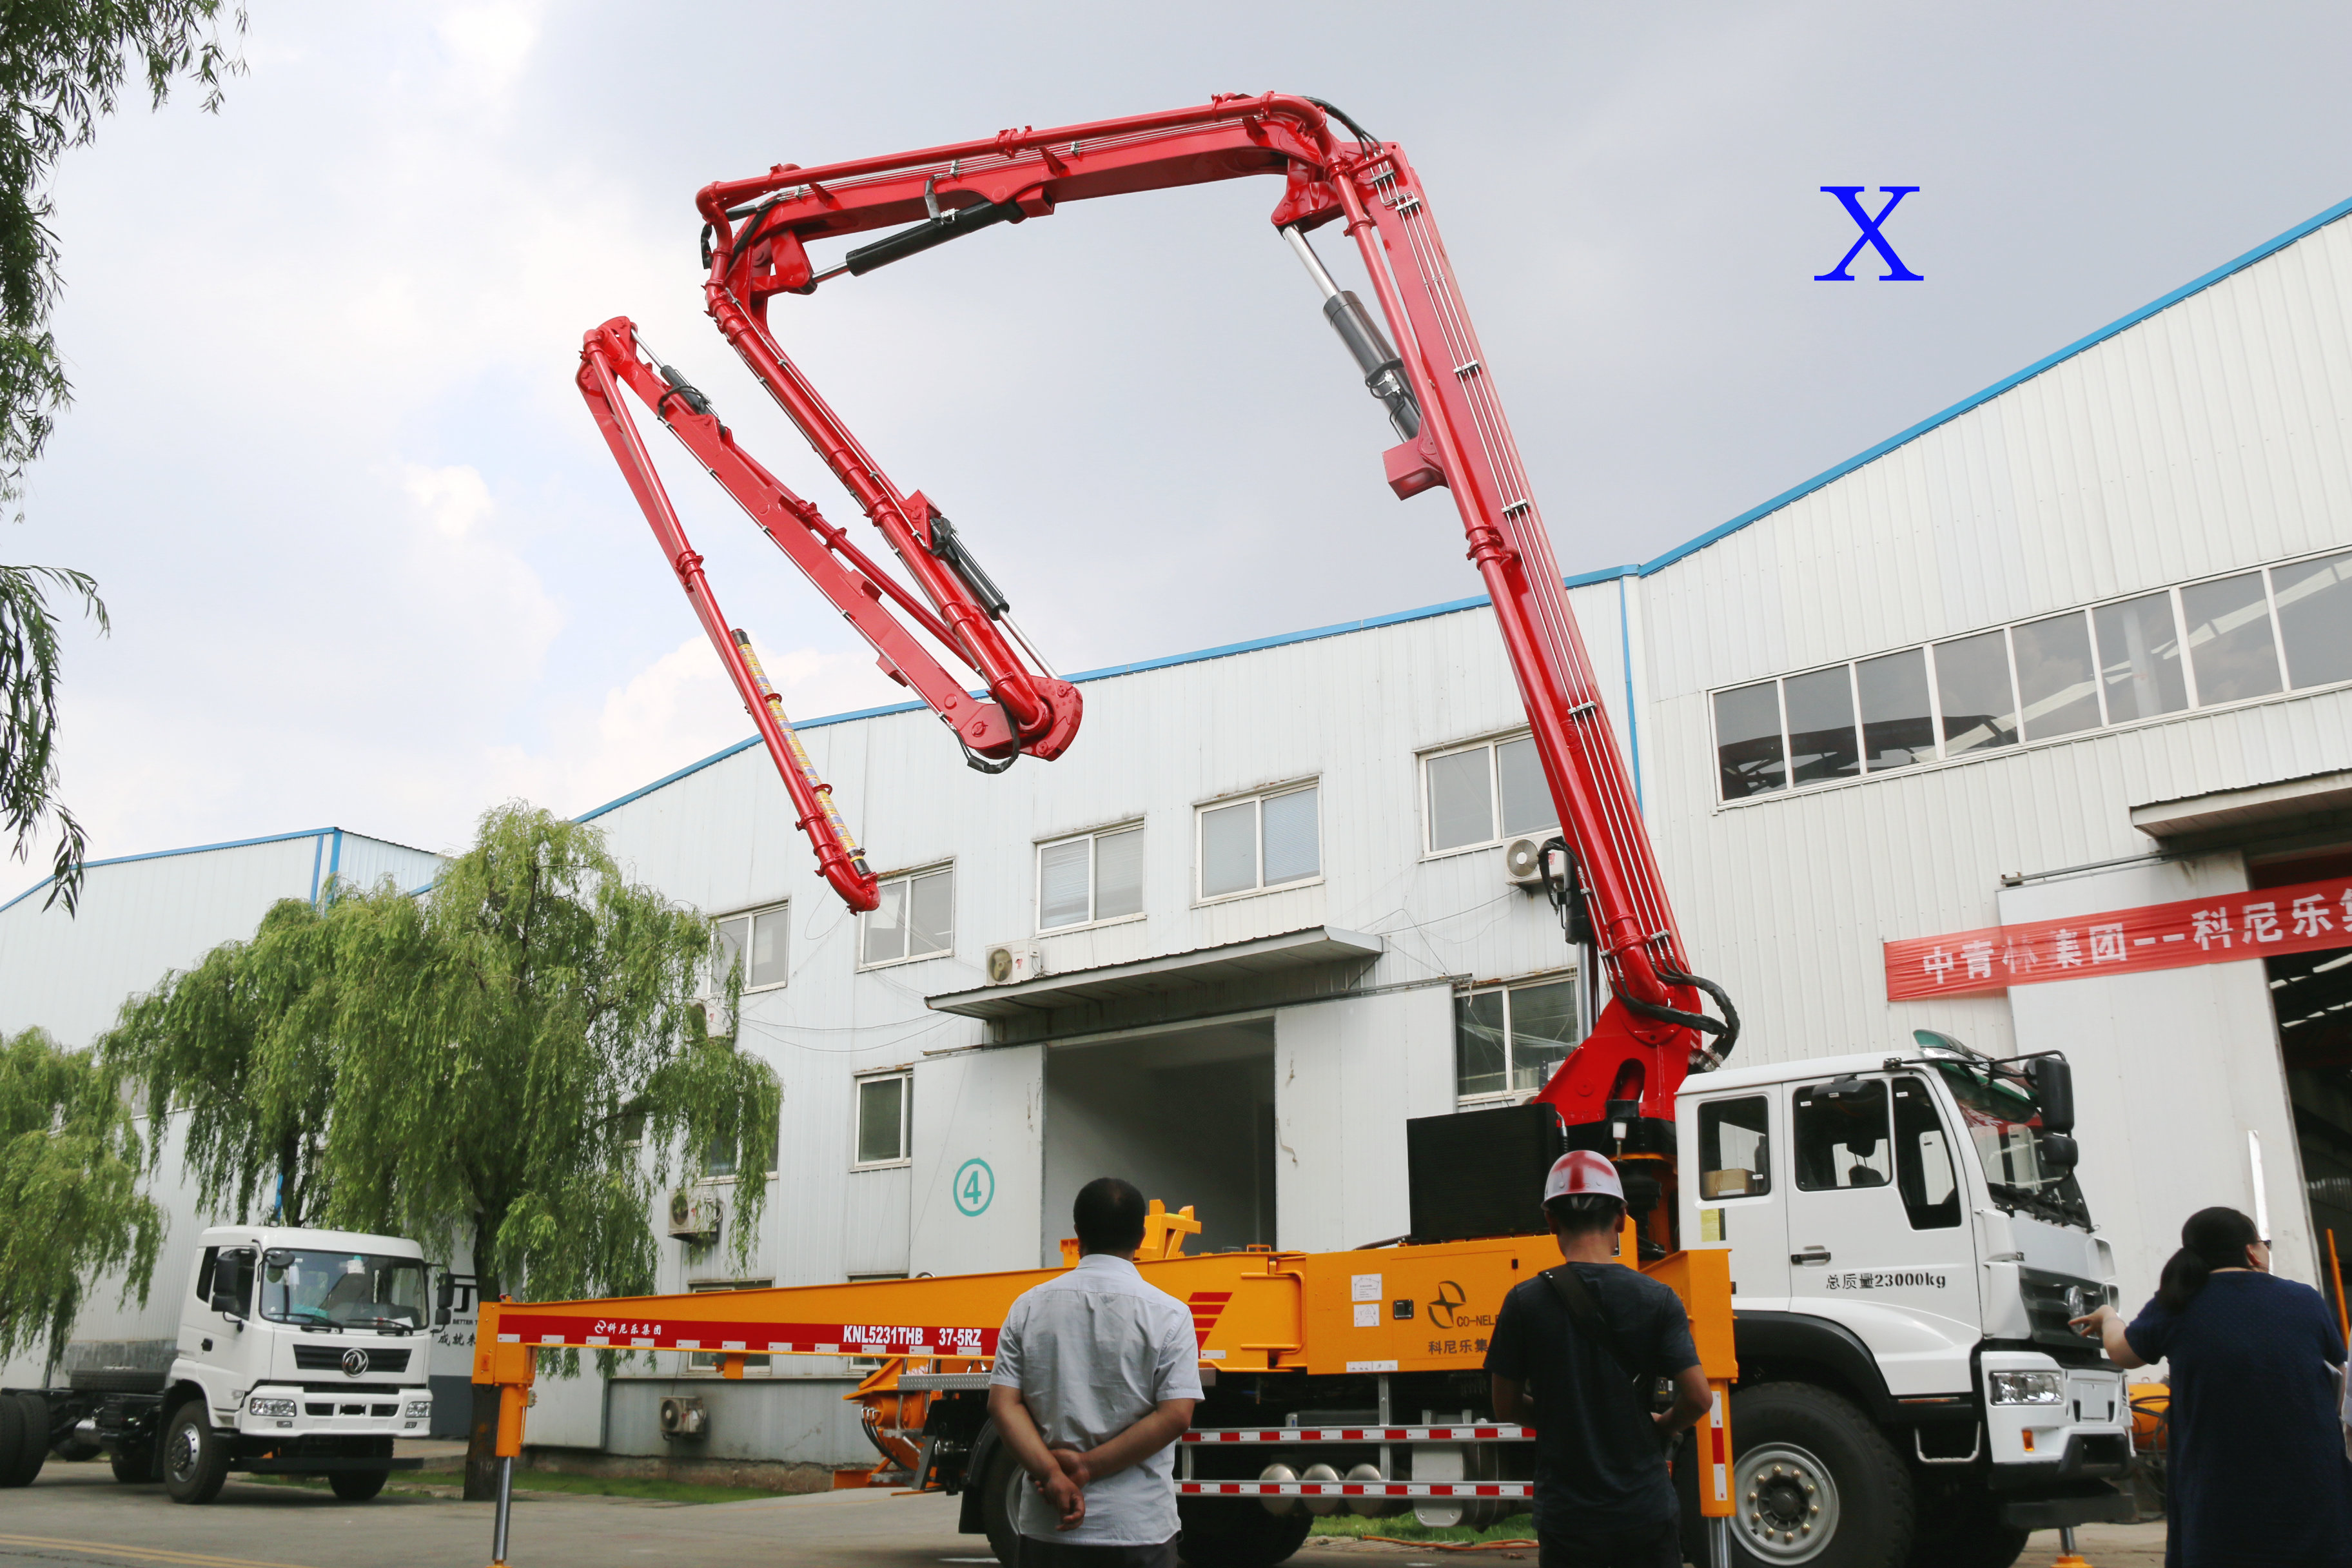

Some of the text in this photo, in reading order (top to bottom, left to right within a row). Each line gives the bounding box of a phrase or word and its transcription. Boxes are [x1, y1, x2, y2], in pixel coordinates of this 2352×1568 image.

[607, 1322, 662, 1335] 科尼乐集团
[843, 1325, 982, 1346] KNL5231THB 37-5RZ
